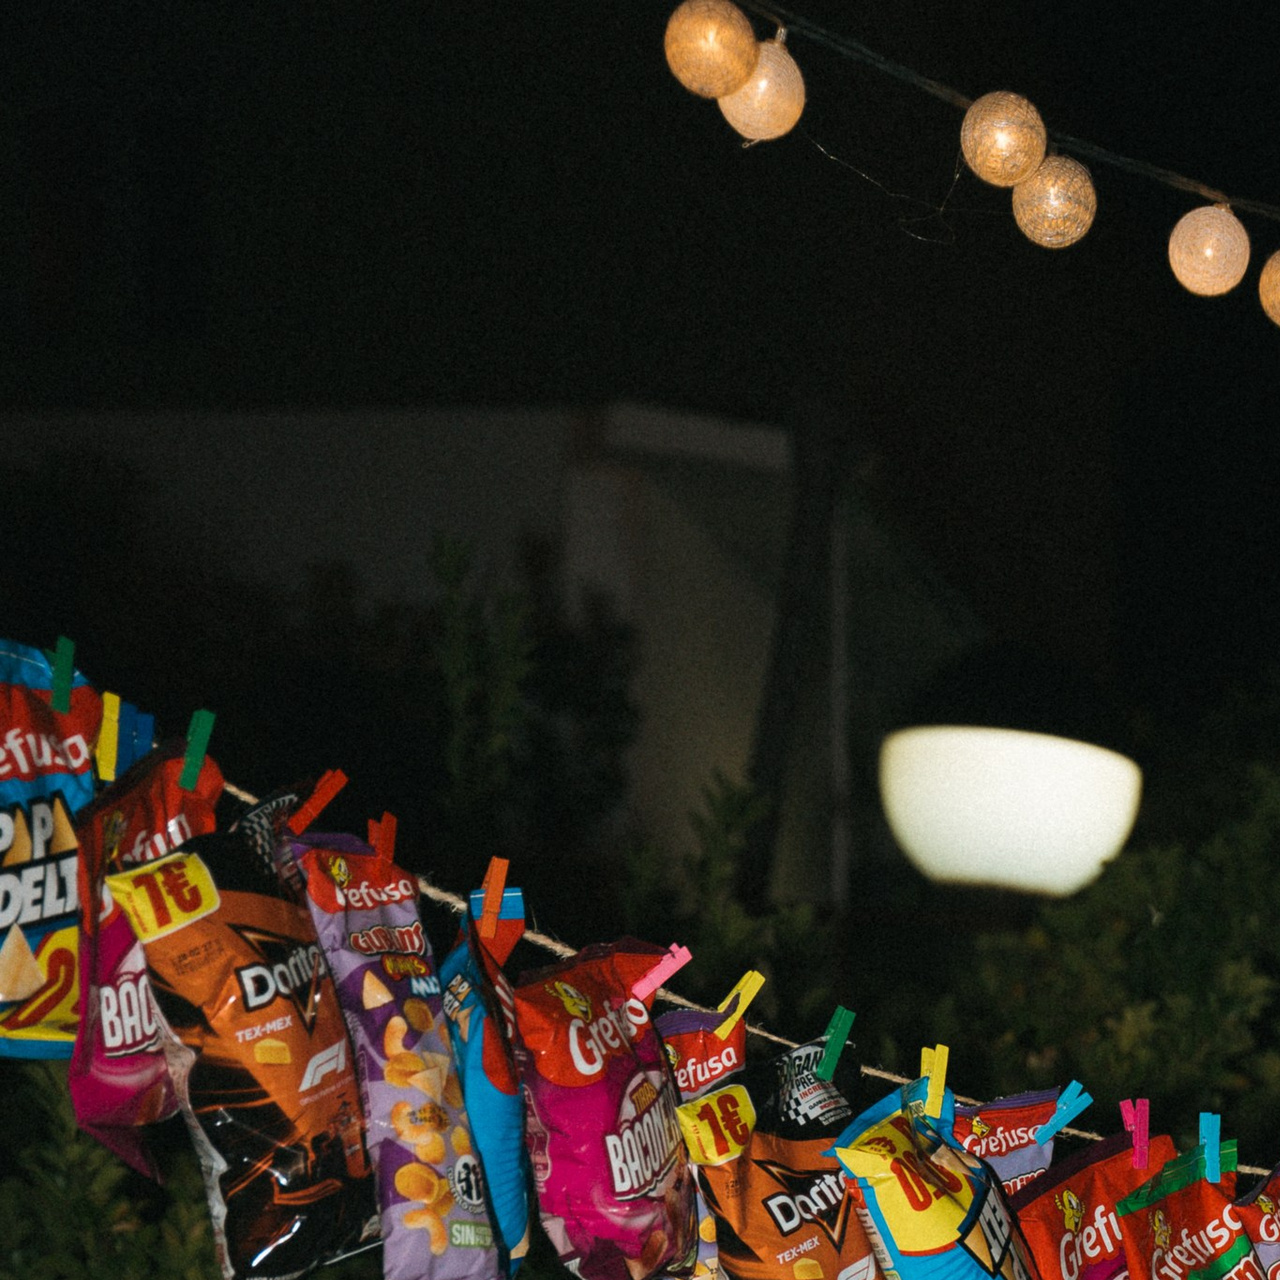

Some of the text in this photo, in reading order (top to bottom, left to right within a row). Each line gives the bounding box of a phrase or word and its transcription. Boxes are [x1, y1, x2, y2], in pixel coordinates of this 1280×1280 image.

[0, 857, 79, 930] DELT
[133, 862, 203, 928] 1€
[335, 879, 414, 907] efusa
[240, 945, 326, 1010] Dorito
[235, 1015, 293, 1043] TEX-MEX
[673, 1046, 738, 1088] efusa
[794, 1050, 824, 1077] GAN
[697, 1093, 750, 1156] 1€
[767, 1170, 846, 1233] Dorit
[451, 1223, 476, 1246] SIN
[776, 1236, 820, 1265] TEX-MEX
